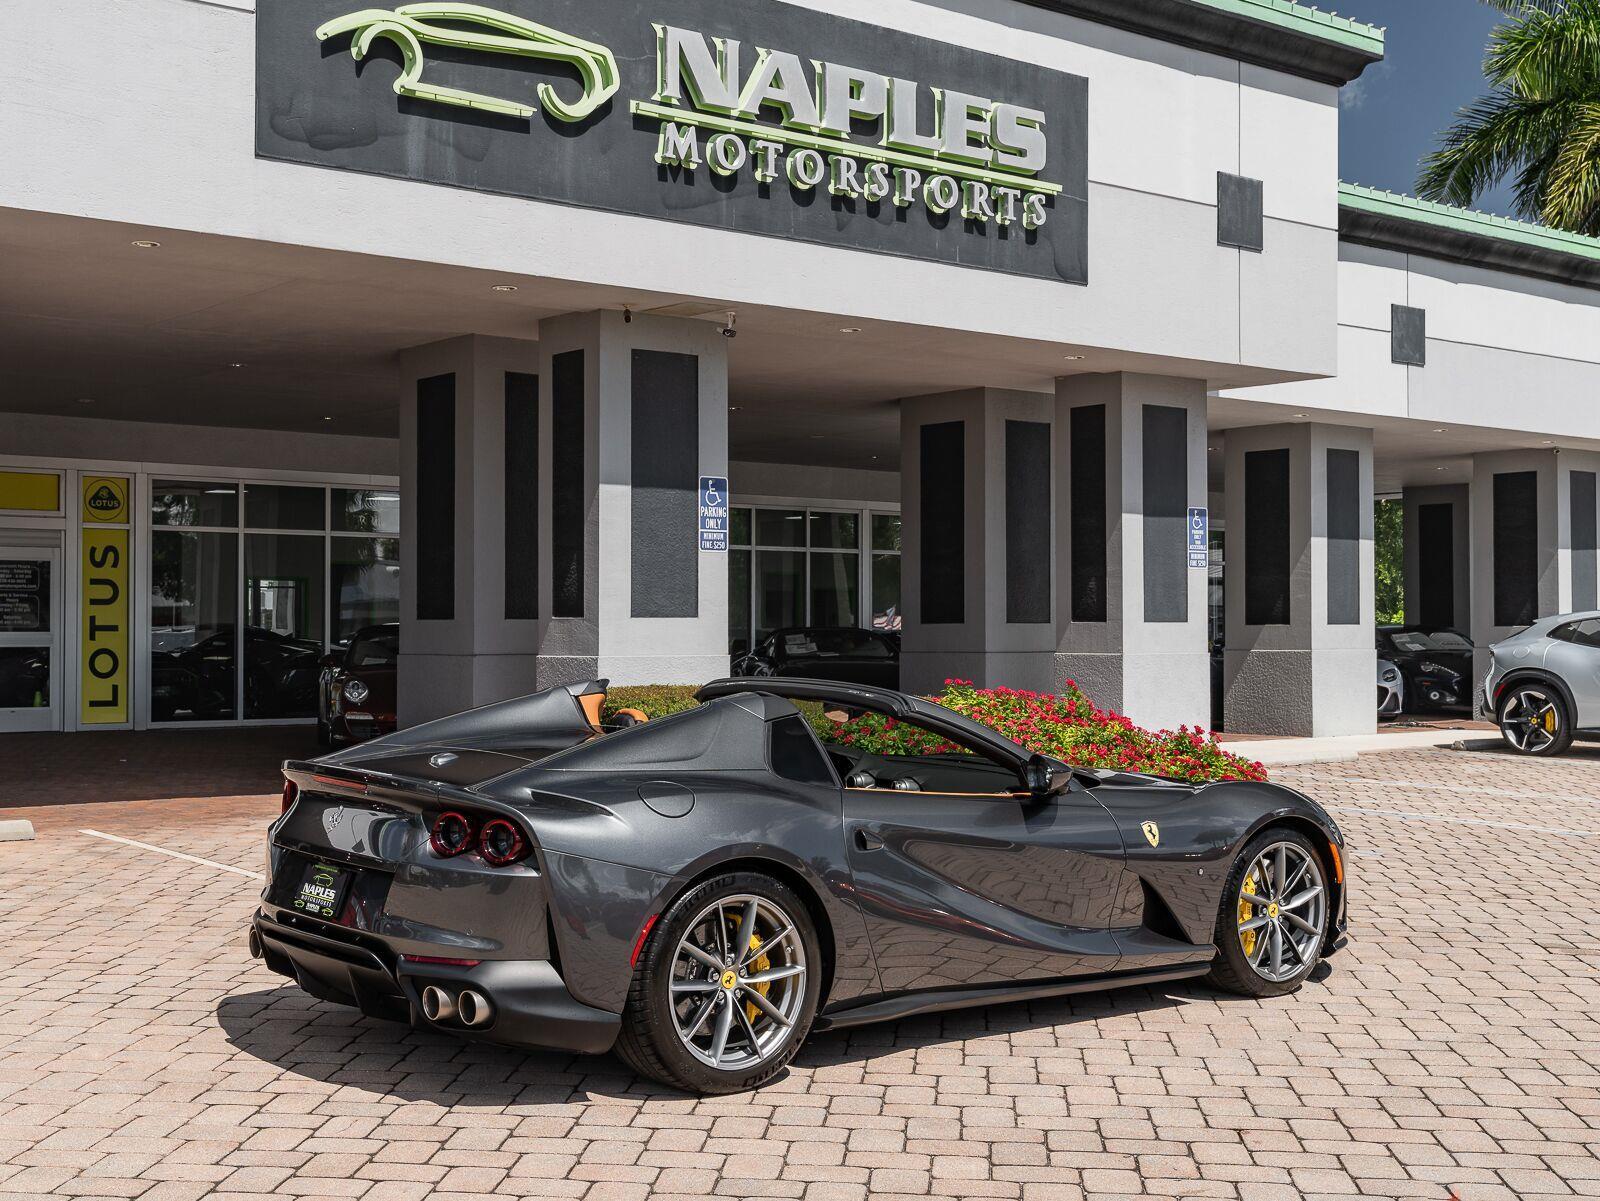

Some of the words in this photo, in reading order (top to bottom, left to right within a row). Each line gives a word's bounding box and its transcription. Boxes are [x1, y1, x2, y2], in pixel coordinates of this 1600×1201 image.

[652, 23, 1047, 174] NAPLES
[655, 122, 1047, 229] MOTORSPORTS
[91, 499, 119, 507] LOTUS
[701, 506, 727, 517] PARKING
[705, 518, 722, 529] ONLY
[703, 532, 724, 541] MINIMUM
[702, 541, 713, 549] FINE
[713, 542, 726, 550] $250
[89, 545, 119, 708] LOTUS
[302, 882, 337, 900] NAPLES
